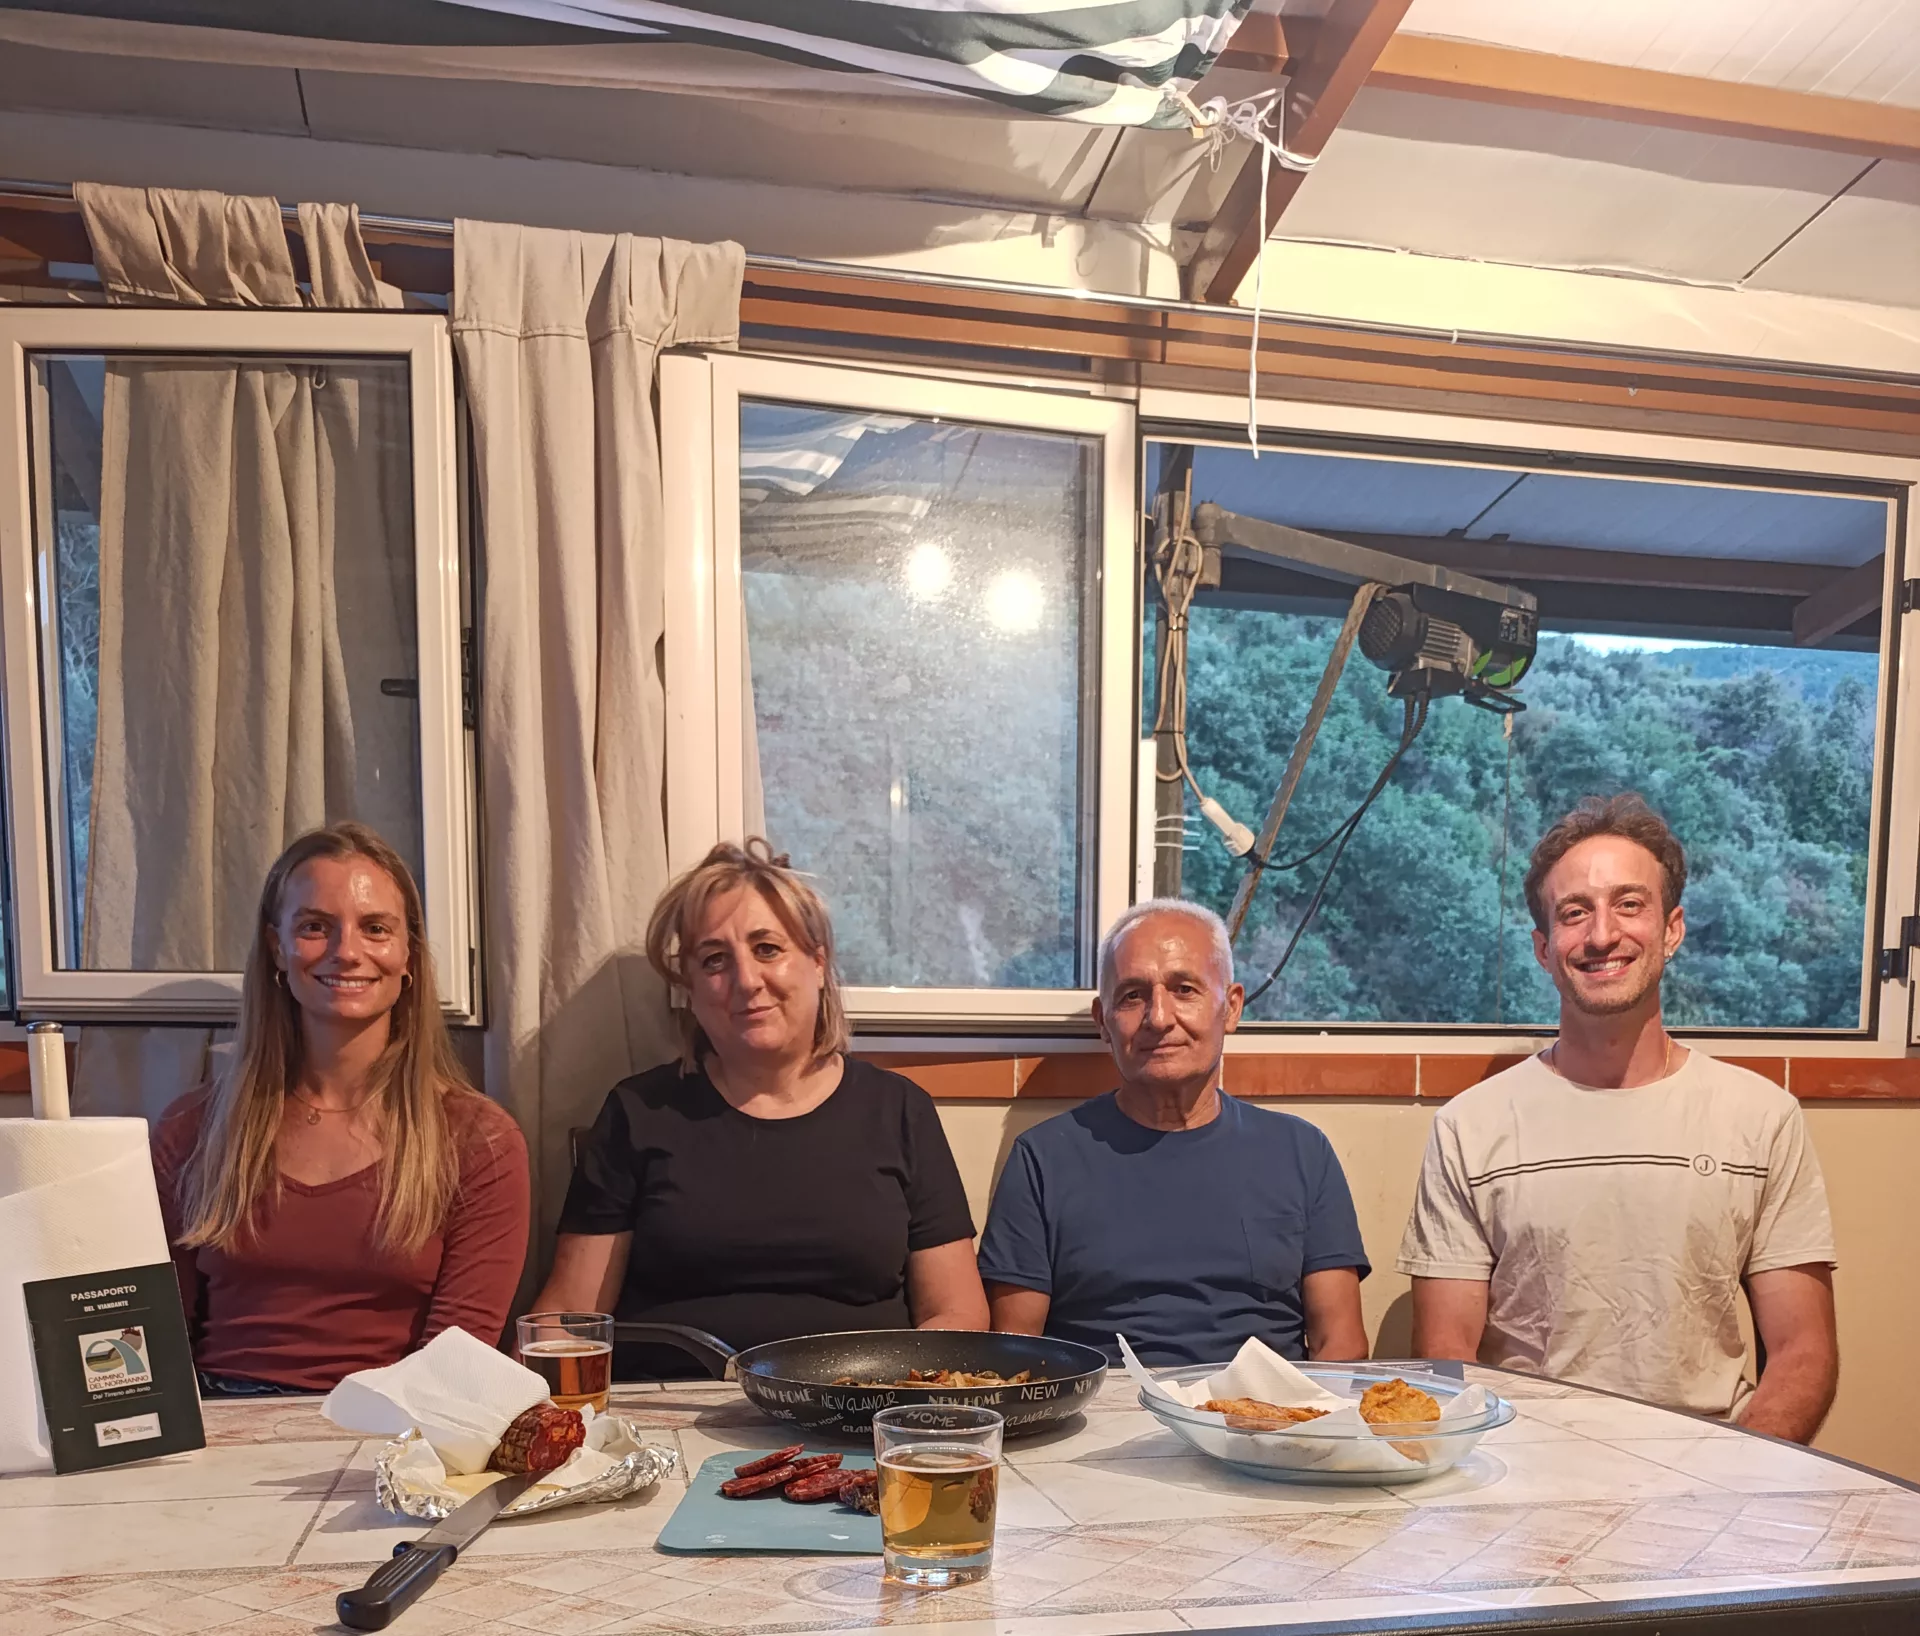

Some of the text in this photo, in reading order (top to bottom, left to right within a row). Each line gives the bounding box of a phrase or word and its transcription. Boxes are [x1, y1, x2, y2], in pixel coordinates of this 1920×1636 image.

[1699, 1160, 1709, 1171] J
[70, 1285, 137, 1302] PASSAPORTO
[97, 1300, 129, 1310] VIANDANTE
[88, 1372, 124, 1383] CAMMINO
[89, 1375, 149, 1390] DEL NORMANNO
[756, 1383, 814, 1403] NEW HOME
[963, 1391, 1004, 1407] HOME
[1021, 1383, 1059, 1400] NEW
[820, 1391, 899, 1414] NEW GLAMOUR
[818, 1413, 845, 1425] HOME
[906, 1410, 958, 1427] HOME
[841, 1424, 873, 1433] GLAM
